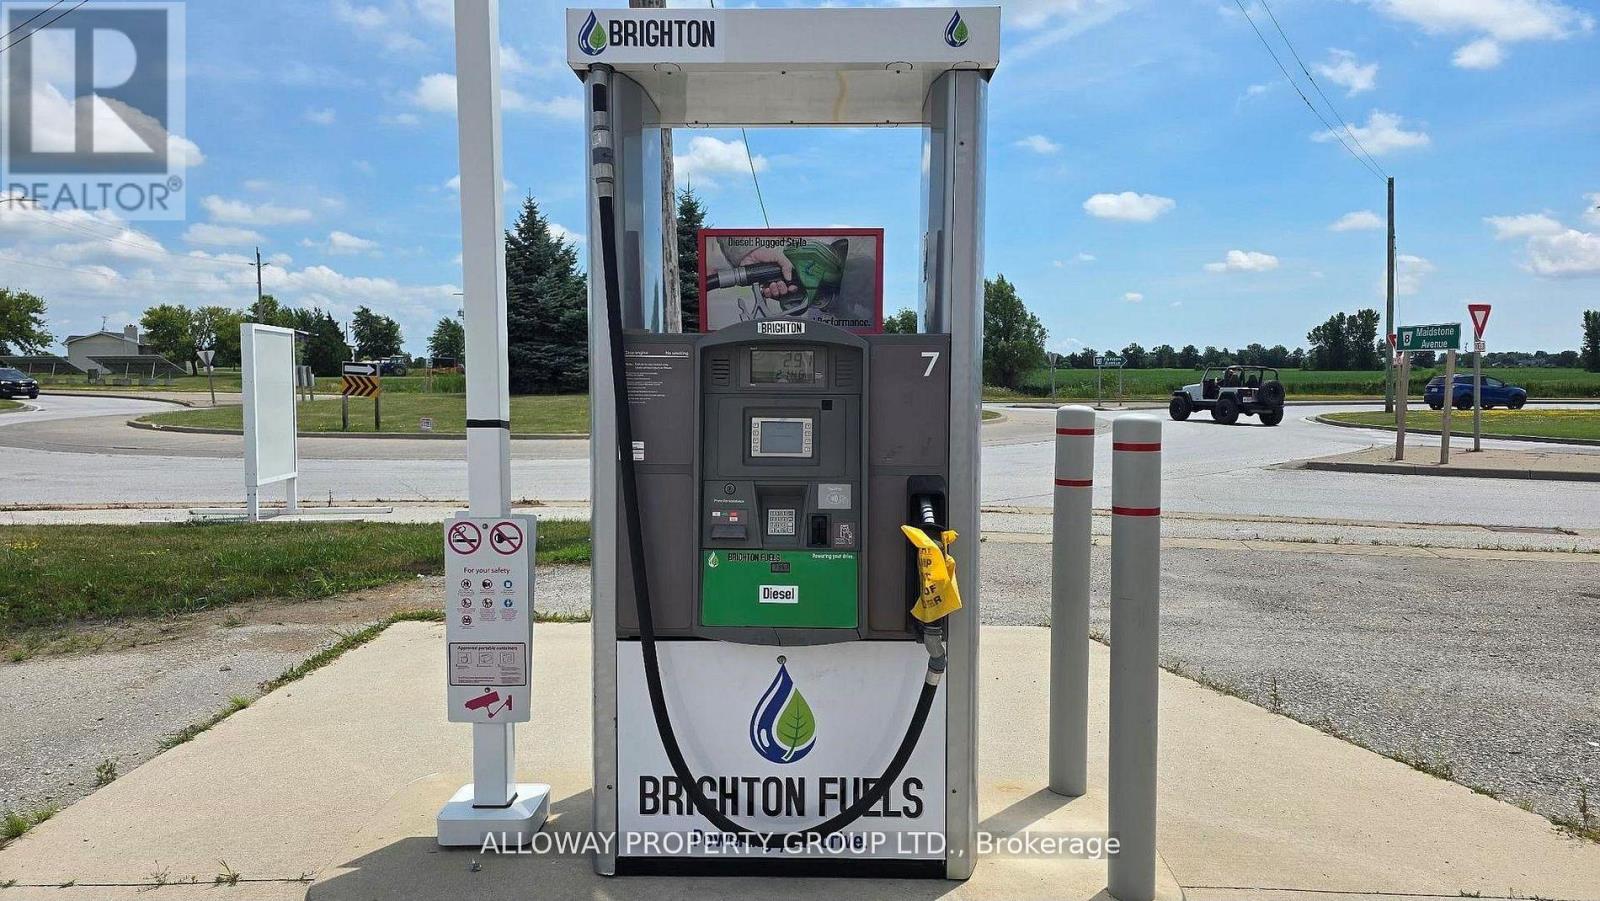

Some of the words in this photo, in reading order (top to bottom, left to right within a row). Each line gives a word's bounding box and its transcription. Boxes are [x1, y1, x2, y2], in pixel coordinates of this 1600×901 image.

[608, 20, 715, 48] BRIGHTON
[755, 237, 786, 248] Rugged
[786, 237, 807, 247] Style
[761, 322, 802, 334] BRIGHTON
[1404, 334, 1410, 344] 8
[1416, 327, 1455, 337] Maidstone
[1420, 339, 1448, 349] Avenue
[921, 351, 940, 377] 7
[727, 552, 759, 562] BRIGHTON
[760, 553, 781, 562] FUELS
[463, 566, 474, 574] For
[491, 566, 511, 575] safety
[762, 586, 795, 600] Diesel
[639, 775, 805, 817] BRIGHTON
[818, 776, 923, 819] FUELS
